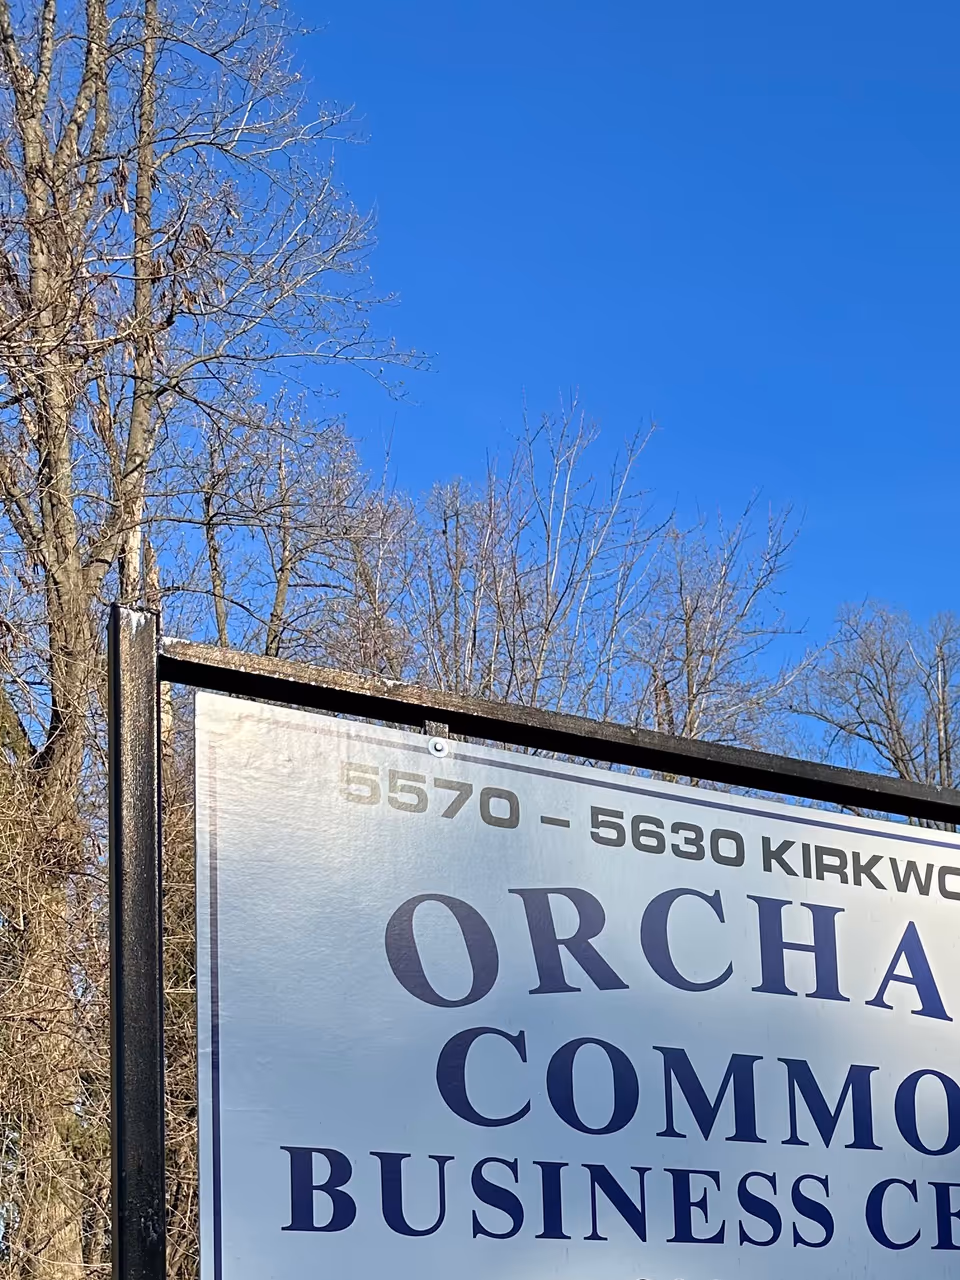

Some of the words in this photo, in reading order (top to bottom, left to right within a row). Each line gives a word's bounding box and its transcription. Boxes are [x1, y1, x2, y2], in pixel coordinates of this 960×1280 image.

[340, 761, 520, 829] 5570
[590, 805, 745, 867] 5630
[280, 1145, 835, 1248] BUSINESS
